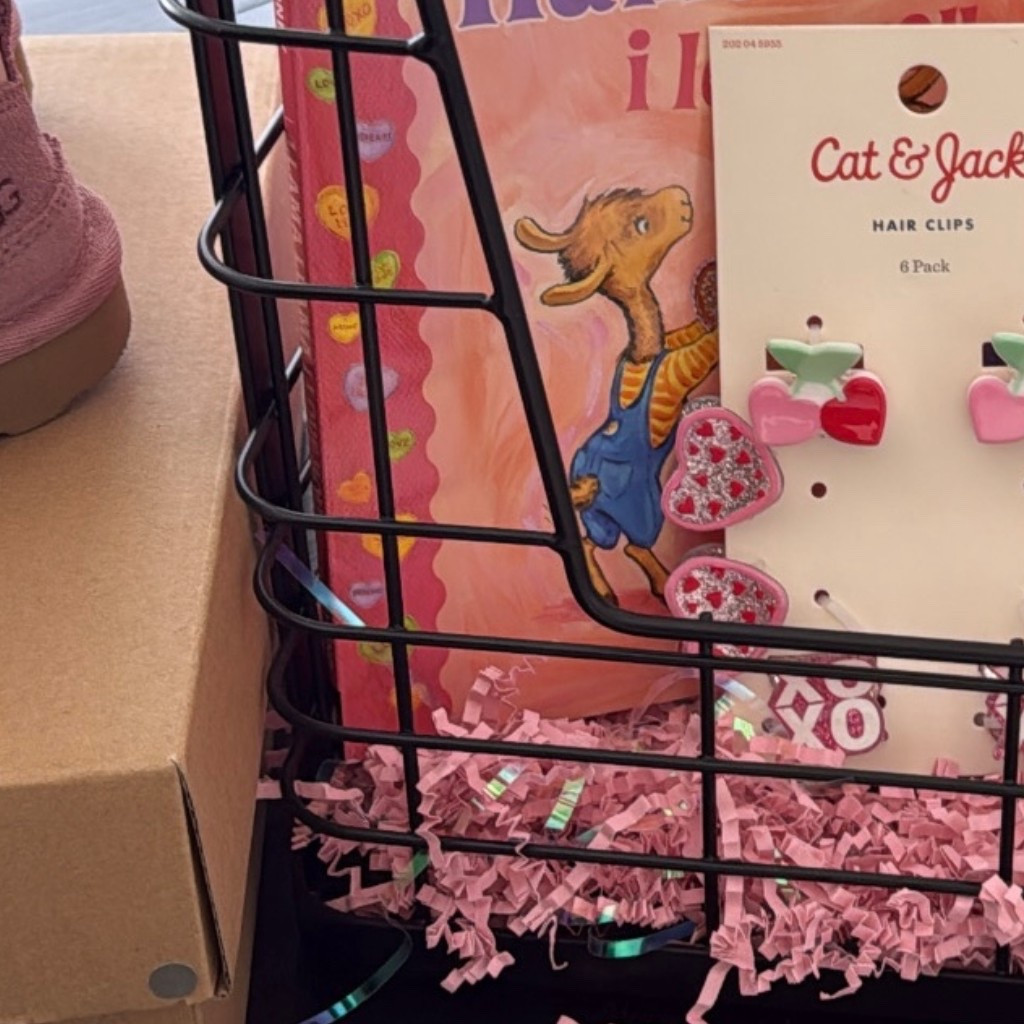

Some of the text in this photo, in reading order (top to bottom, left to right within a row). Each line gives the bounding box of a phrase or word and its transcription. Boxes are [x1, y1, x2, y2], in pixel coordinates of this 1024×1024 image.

[625, 29, 651, 112] i
[811, 136, 882, 183] Cat
[888, 136, 931, 181] &
[872, 218, 975, 233] HAIR CLIPS
[899, 258, 951, 274] 6 Pack
[775, 698, 882, 752] XO
